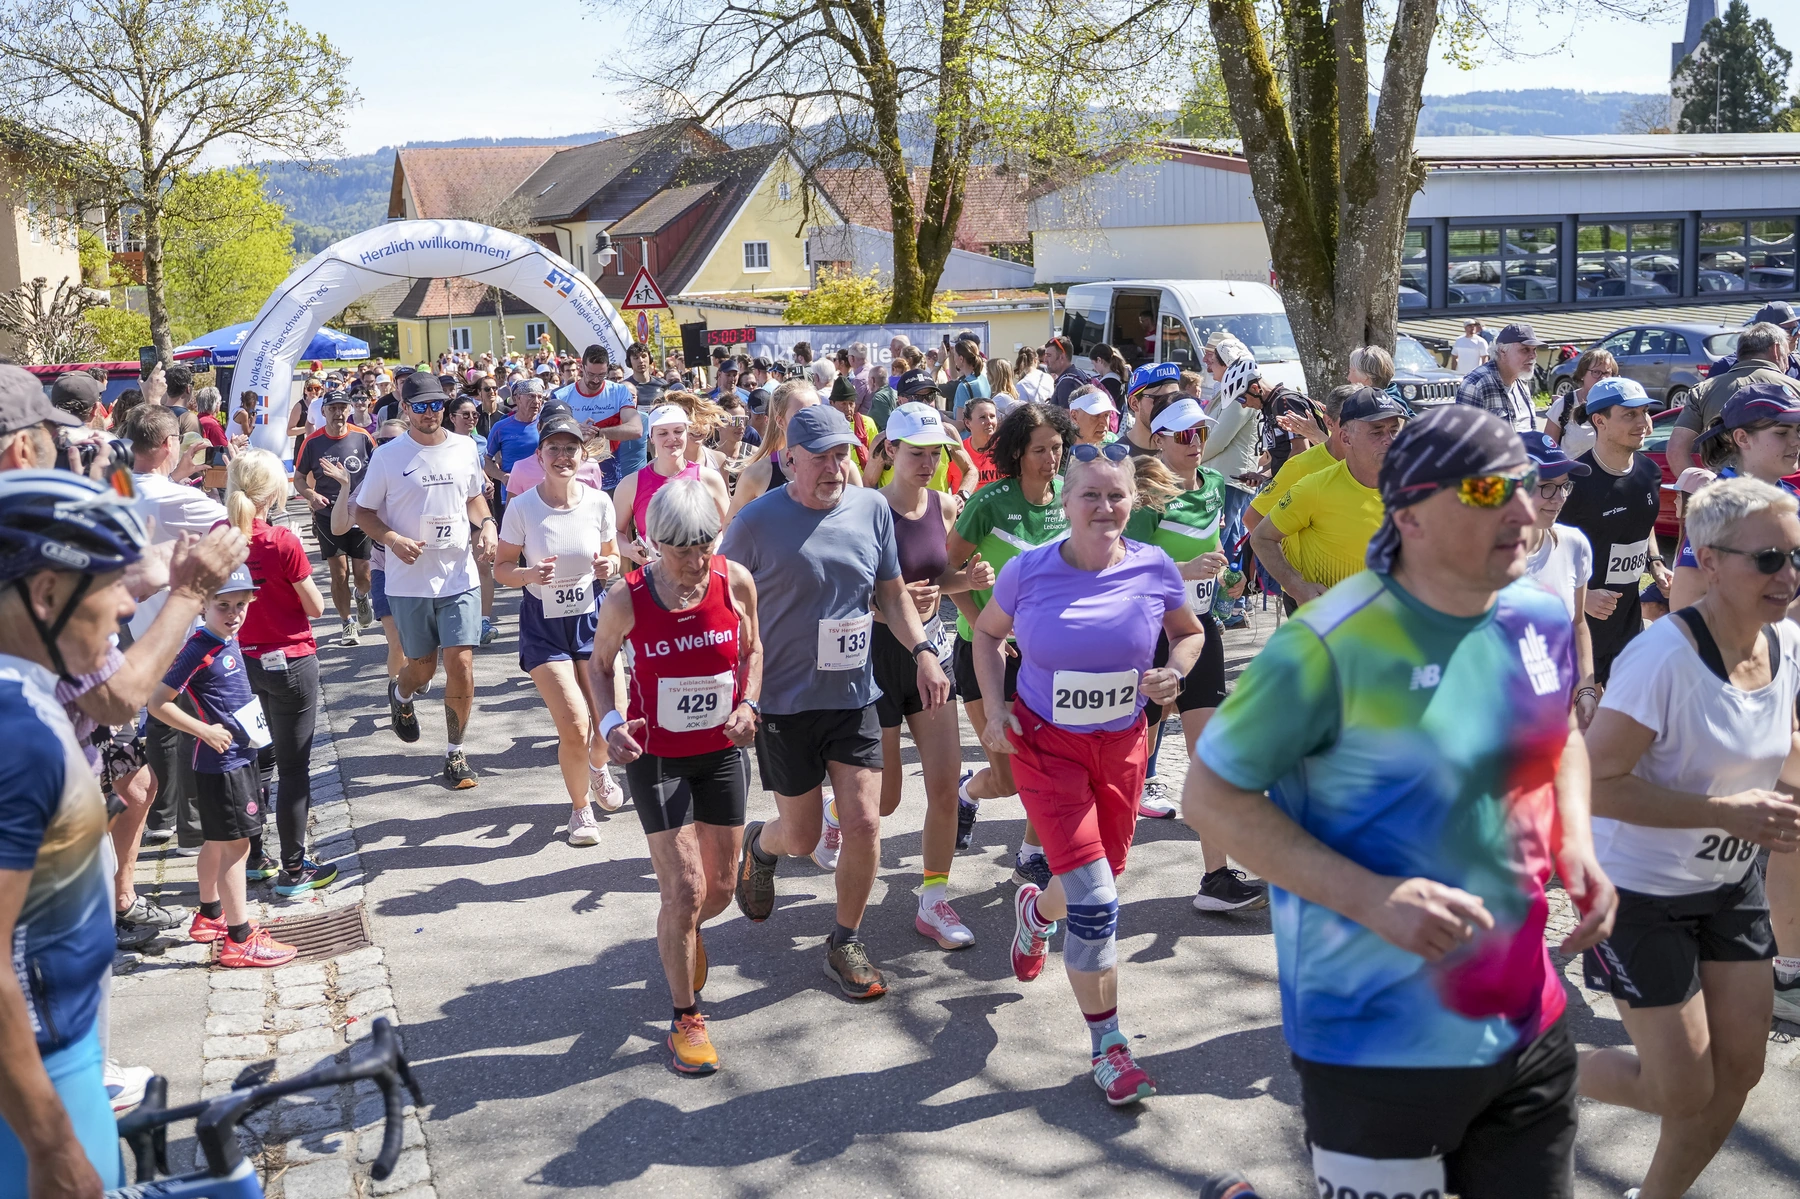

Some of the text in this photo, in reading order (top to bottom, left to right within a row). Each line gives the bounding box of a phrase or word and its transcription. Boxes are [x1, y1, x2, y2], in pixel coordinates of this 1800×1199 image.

[360, 236, 511, 264] Herzlich willkommen!
[579, 290, 611, 330] Volksbank
[260, 284, 329, 390] Allgäu-Oberschwaben eG
[707, 329, 755, 345] 15:00:30
[250, 339, 271, 388] Volksbank
[1156, 367, 1177, 377] ITALIA
[422, 473, 453, 482] S.W.A.T.
[1170, 502, 1183, 510] JAKO
[436, 526, 451, 538] 72
[555, 587, 584, 604] 346
[1196, 581, 1212, 599] 60
[644, 629, 732, 657] LG Welfen
[837, 631, 866, 653] 133
[1409, 664, 1440, 690] NB
[683, 684, 726, 692] Hergensweiler
[1056, 686, 1134, 709] 20912
[677, 692, 718, 713] 429
